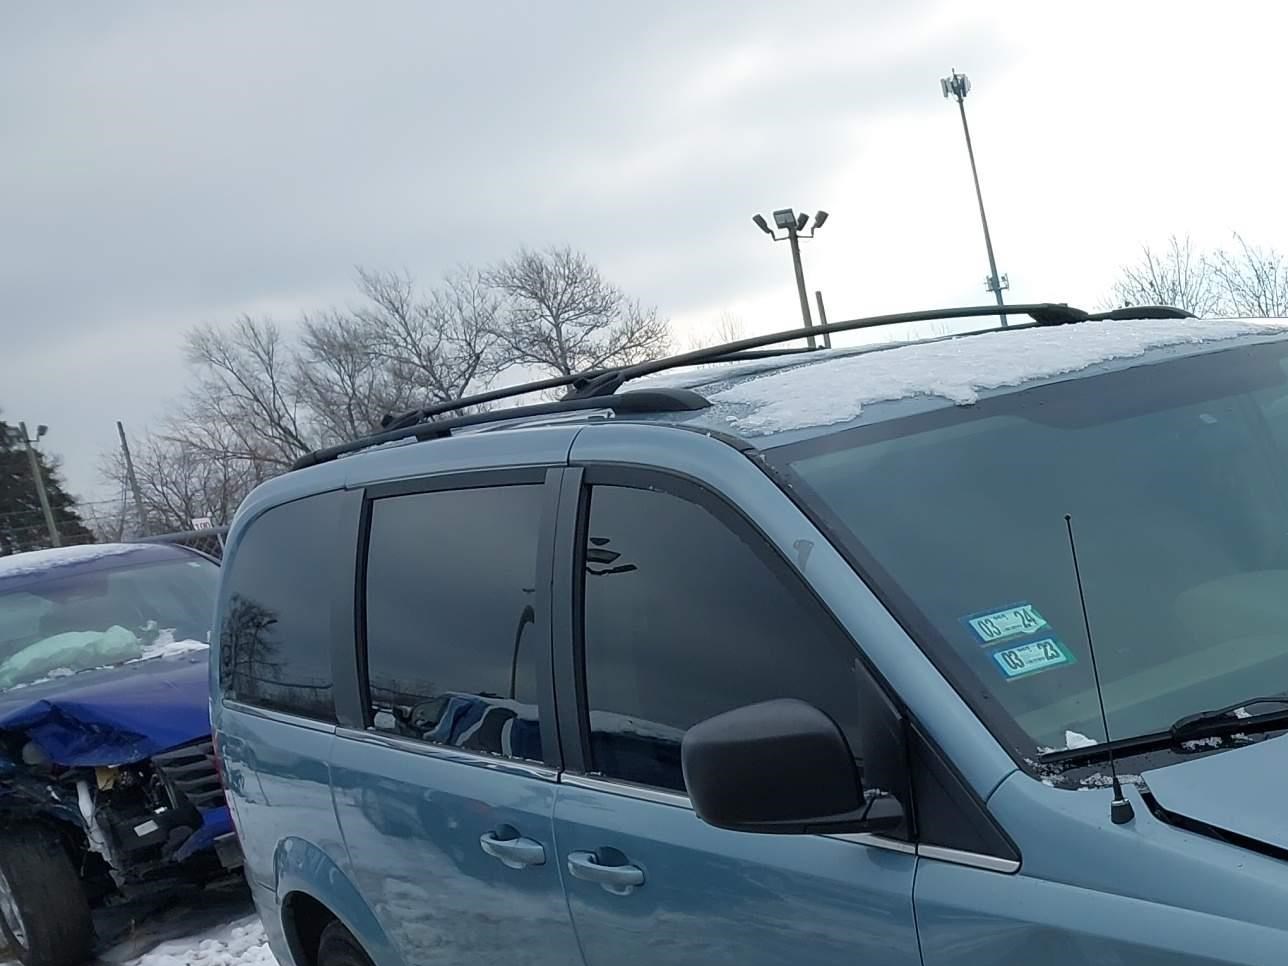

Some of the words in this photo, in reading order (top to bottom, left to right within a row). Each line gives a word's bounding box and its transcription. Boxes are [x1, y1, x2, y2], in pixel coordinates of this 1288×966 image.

[978, 618, 1001, 638] 03
[1014, 608, 1037, 628] 24
[1001, 651, 1025, 669] 03
[1037, 642, 1060, 660] 23
